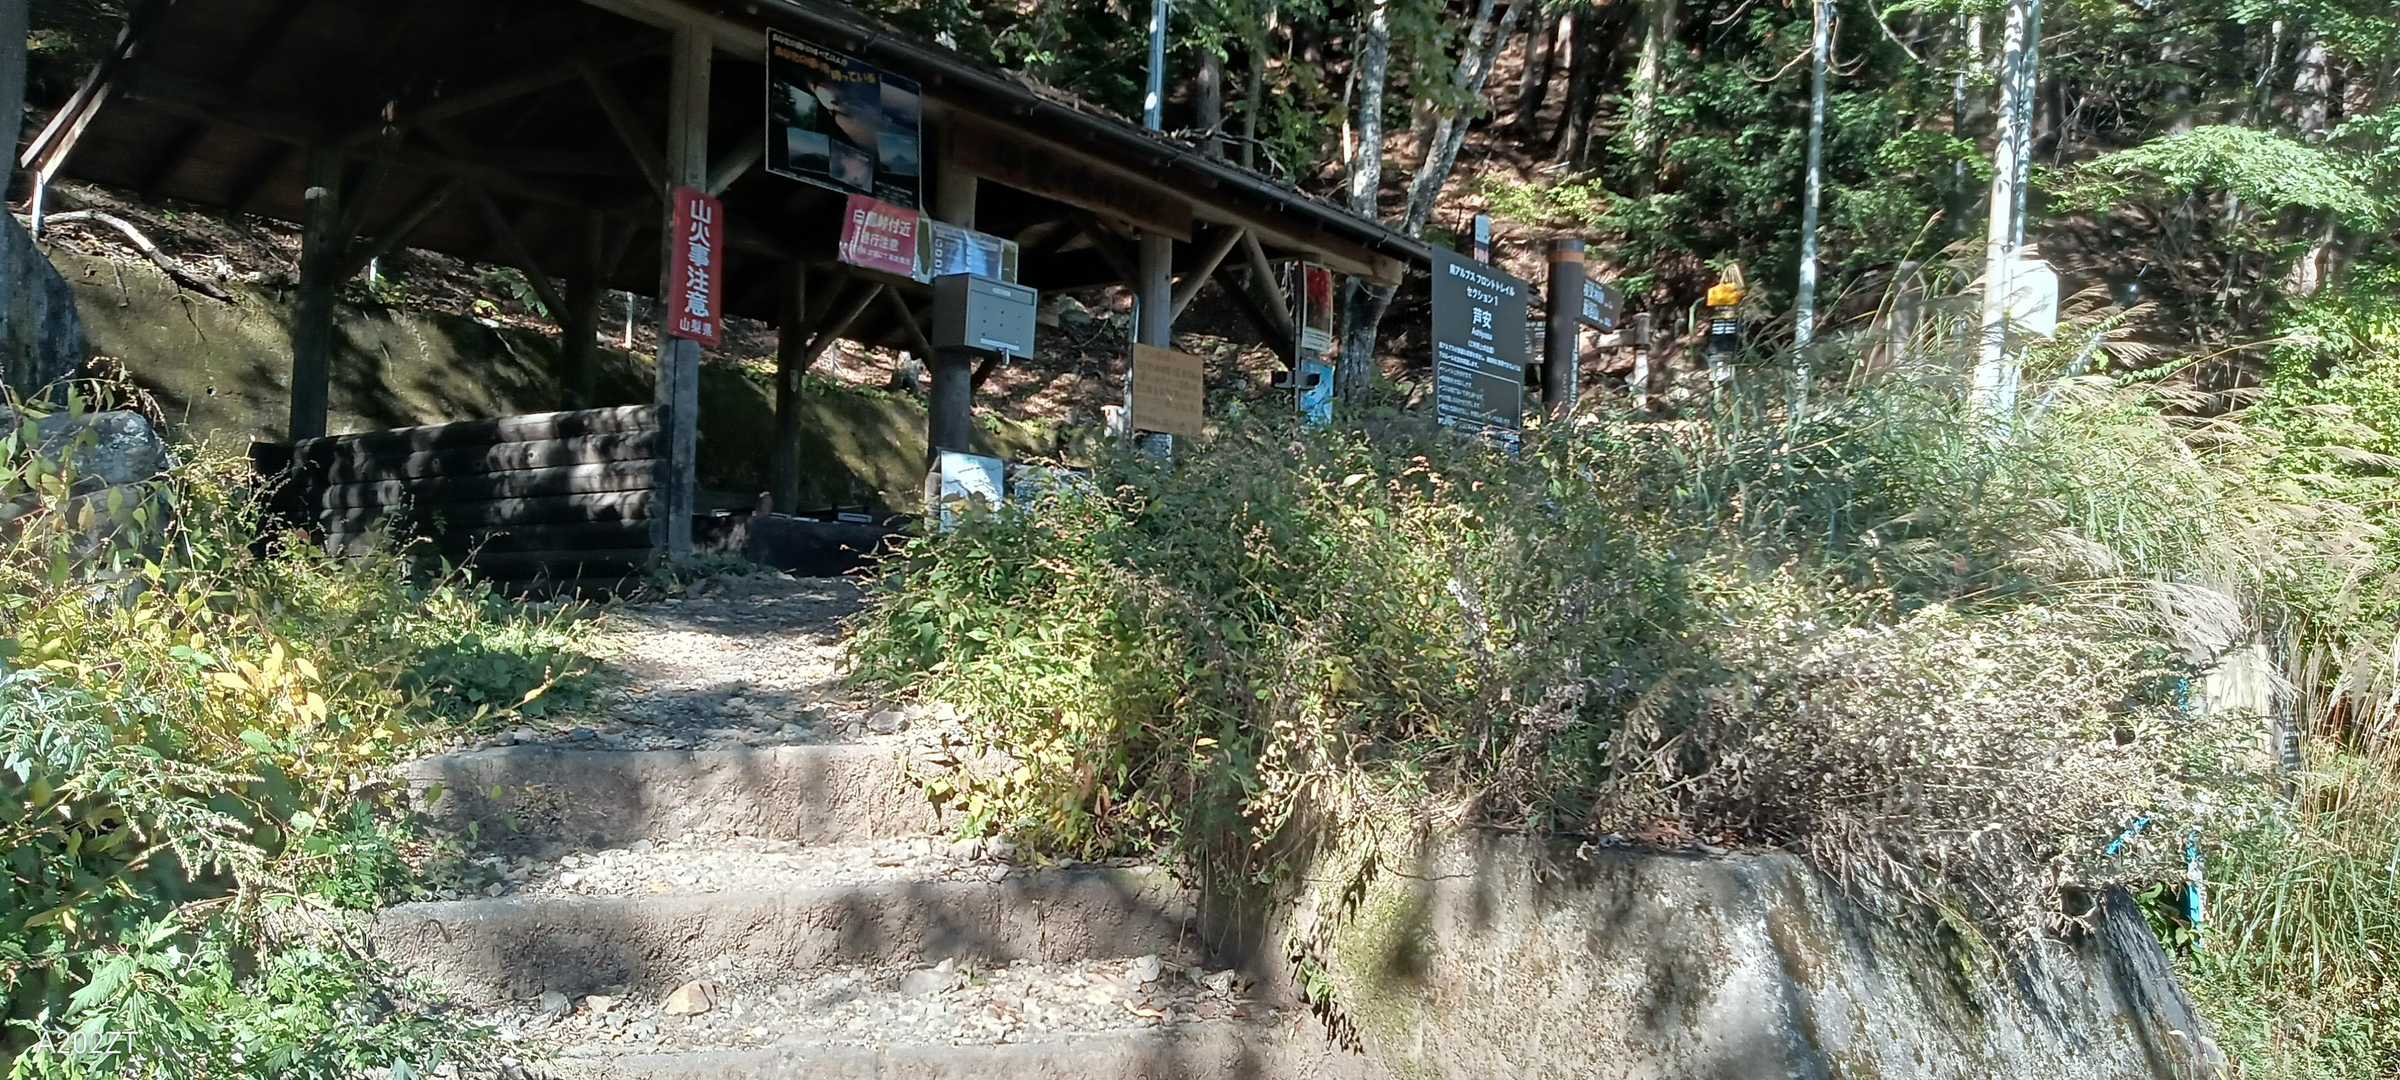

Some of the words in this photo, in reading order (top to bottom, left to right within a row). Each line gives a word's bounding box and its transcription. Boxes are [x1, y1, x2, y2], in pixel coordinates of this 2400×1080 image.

[684, 200, 712, 318] 山火事注意
[679, 317, 713, 336] 山梨県
[1472, 307, 1492, 329] 芦安
